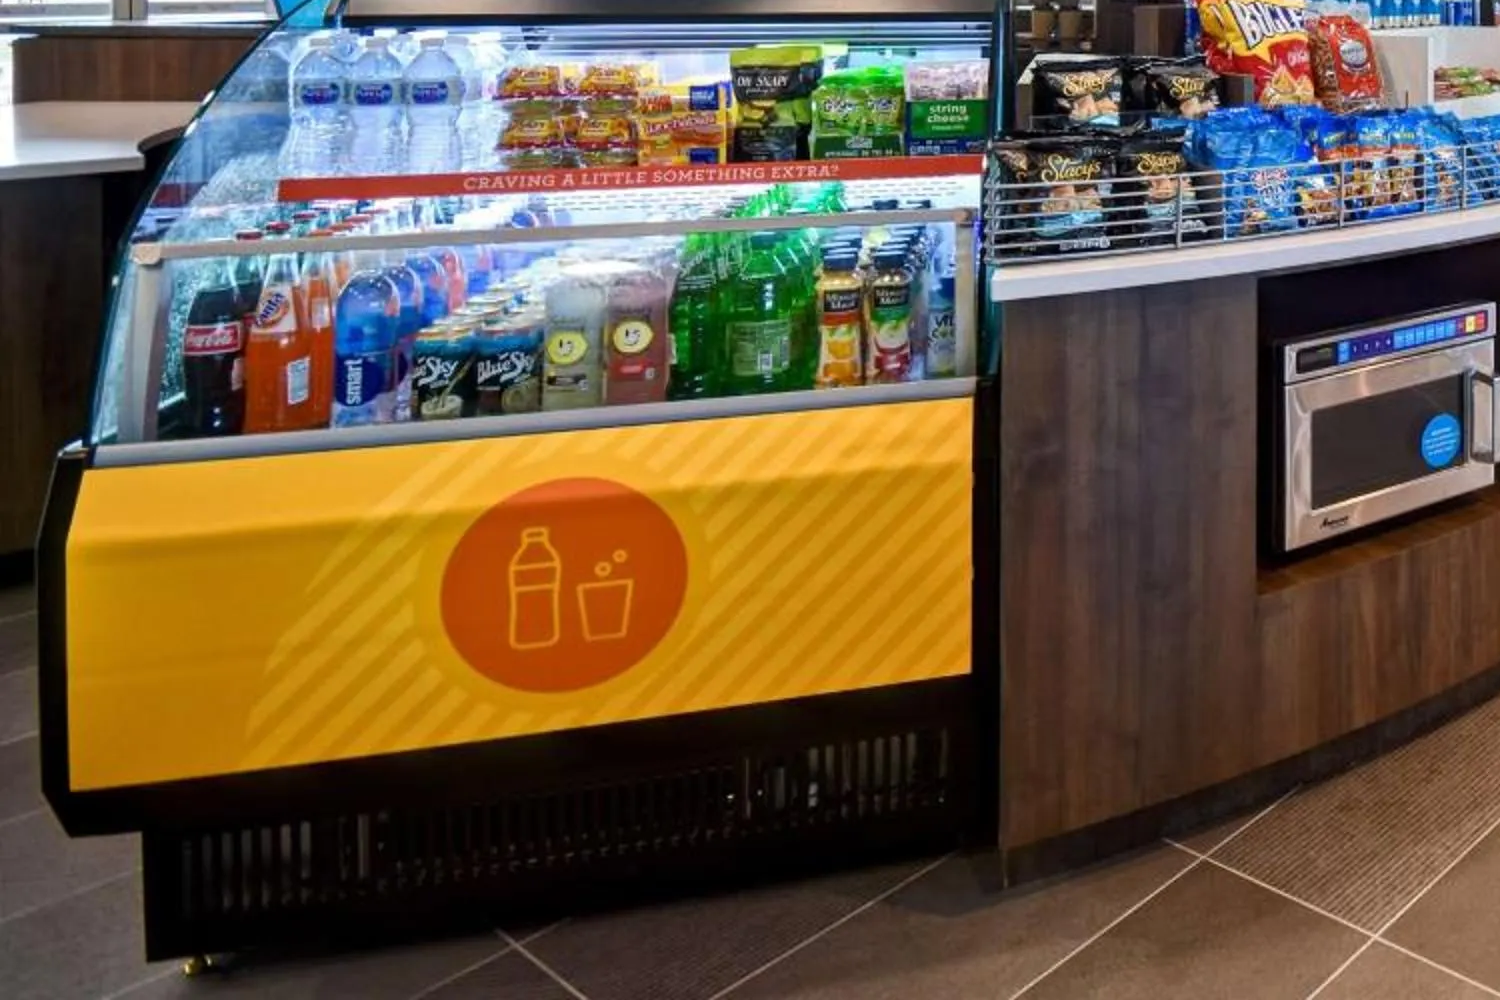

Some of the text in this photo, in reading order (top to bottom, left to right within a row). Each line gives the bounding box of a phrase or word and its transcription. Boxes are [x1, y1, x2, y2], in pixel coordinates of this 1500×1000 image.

[927, 114, 970, 123] cheese
[929, 103, 967, 115] string
[463, 164, 840, 190] CRAVING A LITTLE SOMETHING EXTRA?
[1041, 154, 1101, 183] Stacy's
[343, 358, 363, 405] smart
[418, 356, 459, 387] Sky
